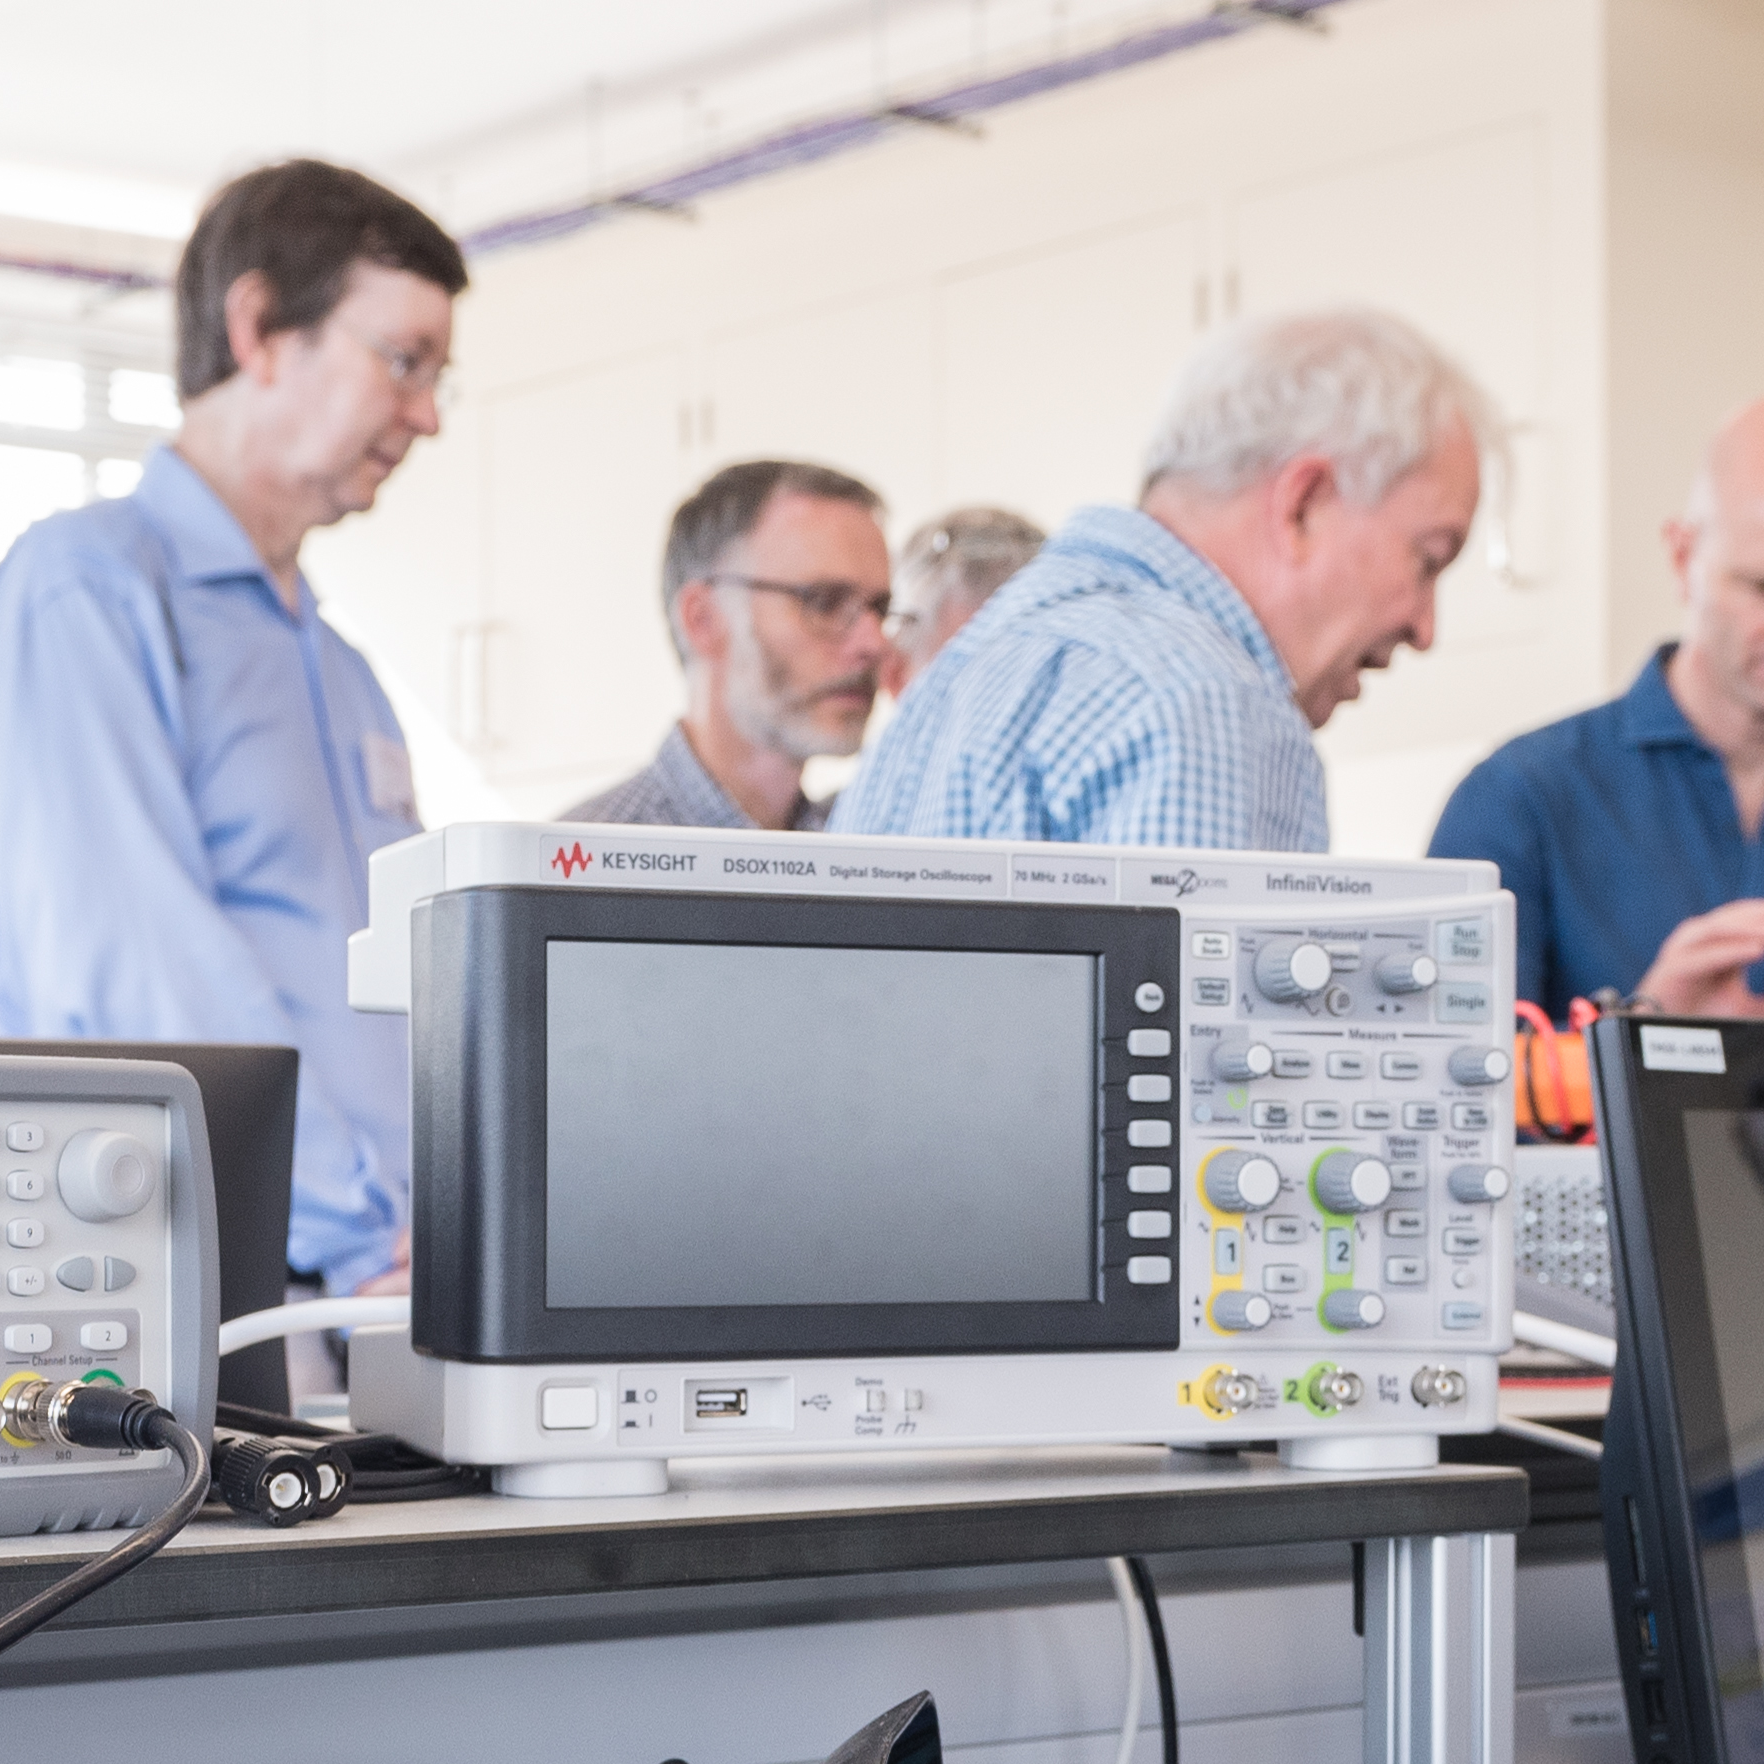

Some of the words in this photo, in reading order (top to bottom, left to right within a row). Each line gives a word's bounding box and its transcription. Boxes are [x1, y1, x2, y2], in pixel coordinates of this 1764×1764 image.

[602, 852, 697, 871] KEYSIGHT
[723, 858, 817, 876] DSOX1102A
[829, 865, 868, 881] Digital
[871, 867, 916, 882] Storage
[920, 868, 993, 884] Oscilloscope
[1014, 870, 1028, 882] 70
[1031, 871, 1056, 884] MHz
[1062, 872, 1069, 884] 2
[1266, 873, 1372, 894] InfiniiVision
[1307, 928, 1369, 942] Horizontal
[1453, 926, 1478, 940] Run
[1451, 944, 1480, 959] Stop
[1446, 993, 1487, 1010] Single
[1190, 1024, 1222, 1039] Entry
[1348, 1028, 1397, 1041] Measure
[27, 1132, 33, 1142] 3
[1260, 1132, 1305, 1144] Vertical
[1443, 1136, 1480, 1149] Trigger
[27, 1180, 33, 1190] 6
[27, 1228, 33, 1238] 9
[1227, 1242, 1236, 1262] 1
[1337, 1242, 1349, 1262] 2
[24, 1275, 37, 1286] +/-
[105, 1331, 111, 1342] 2
[31, 1355, 66, 1367] Channel
[69, 1355, 93, 1367] Setup
[1377, 1374, 1399, 1387] Ext
[1182, 1384, 1191, 1402] 1
[1287, 1382, 1298, 1402] 2
